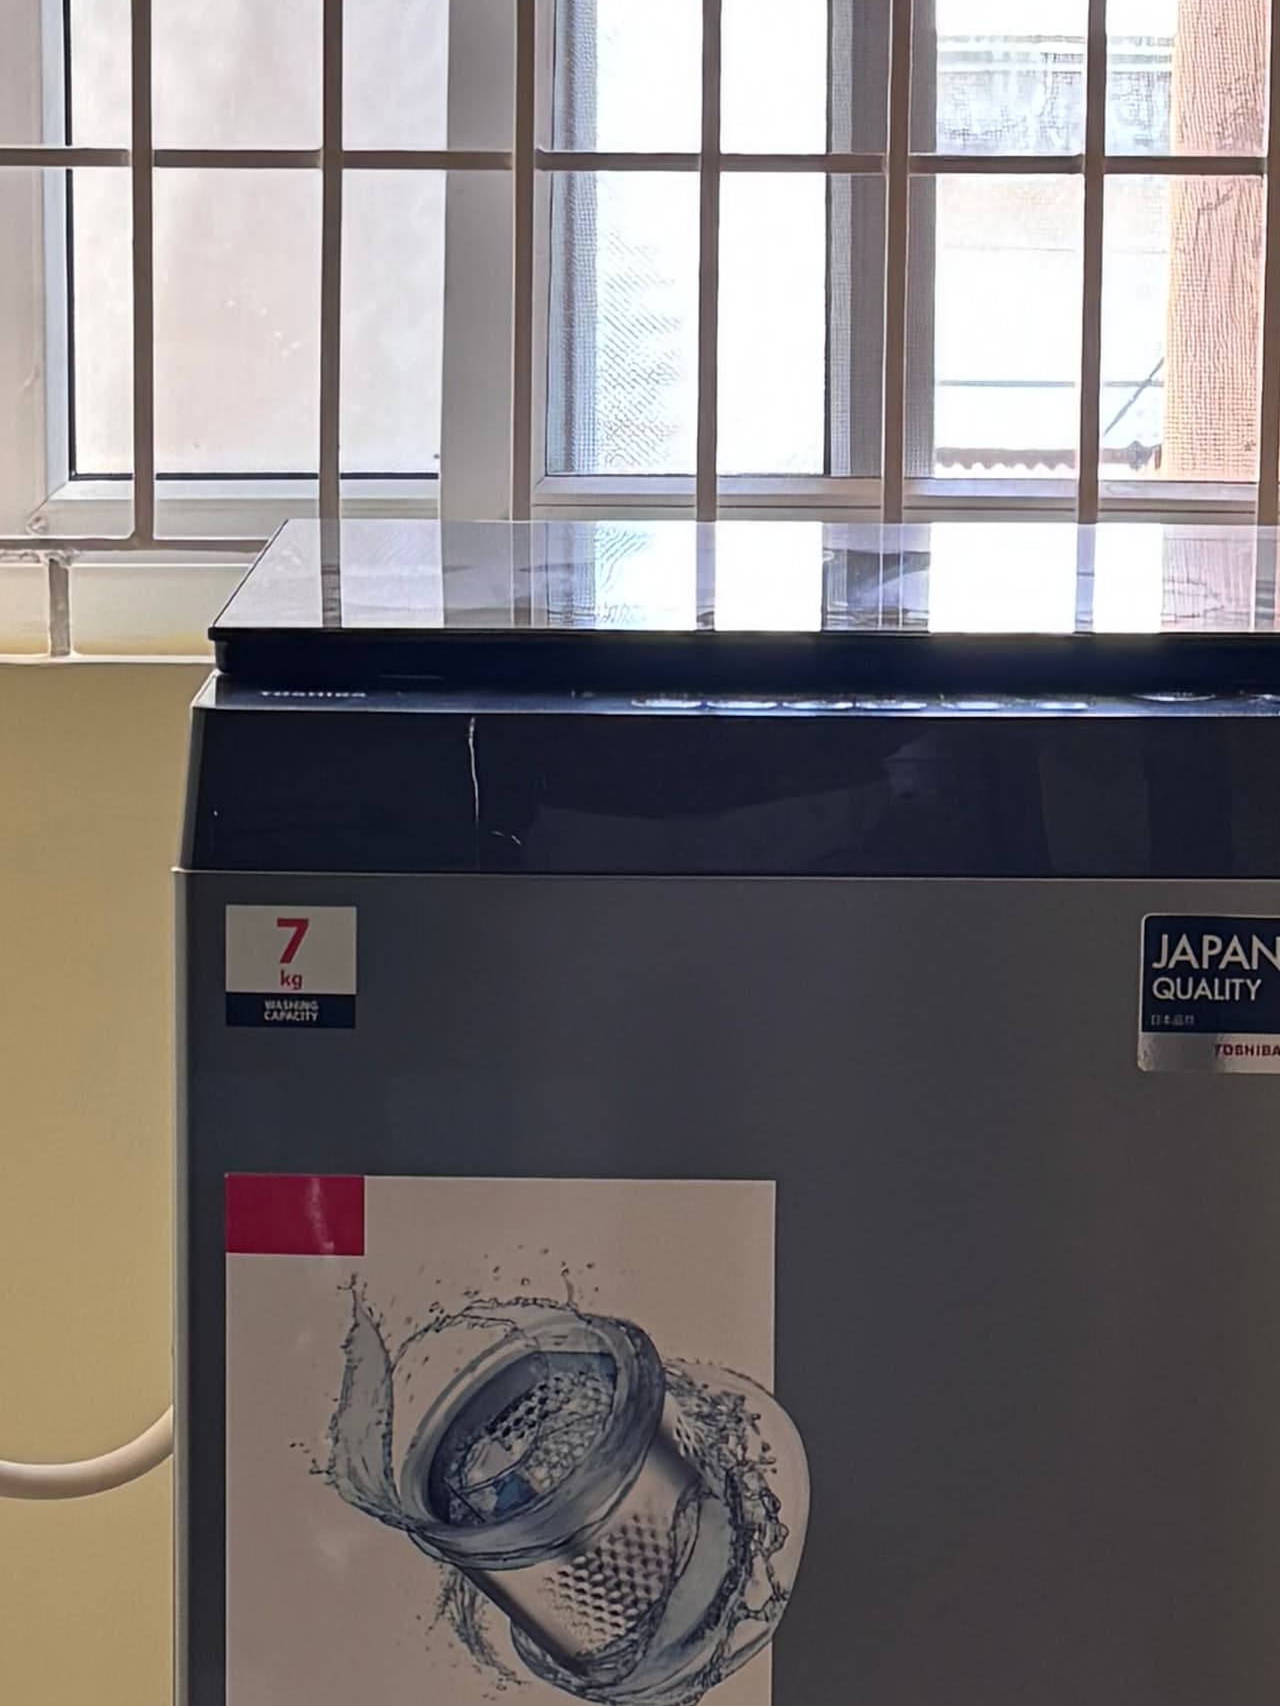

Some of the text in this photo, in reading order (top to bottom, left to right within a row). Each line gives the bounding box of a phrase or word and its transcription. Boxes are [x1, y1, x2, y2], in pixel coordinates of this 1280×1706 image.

[277, 918, 309, 964] 7
[281, 970, 302, 990] kg
[1152, 976, 1262, 1001] QUALITY
[264, 1010, 319, 1022] CAPACITY
